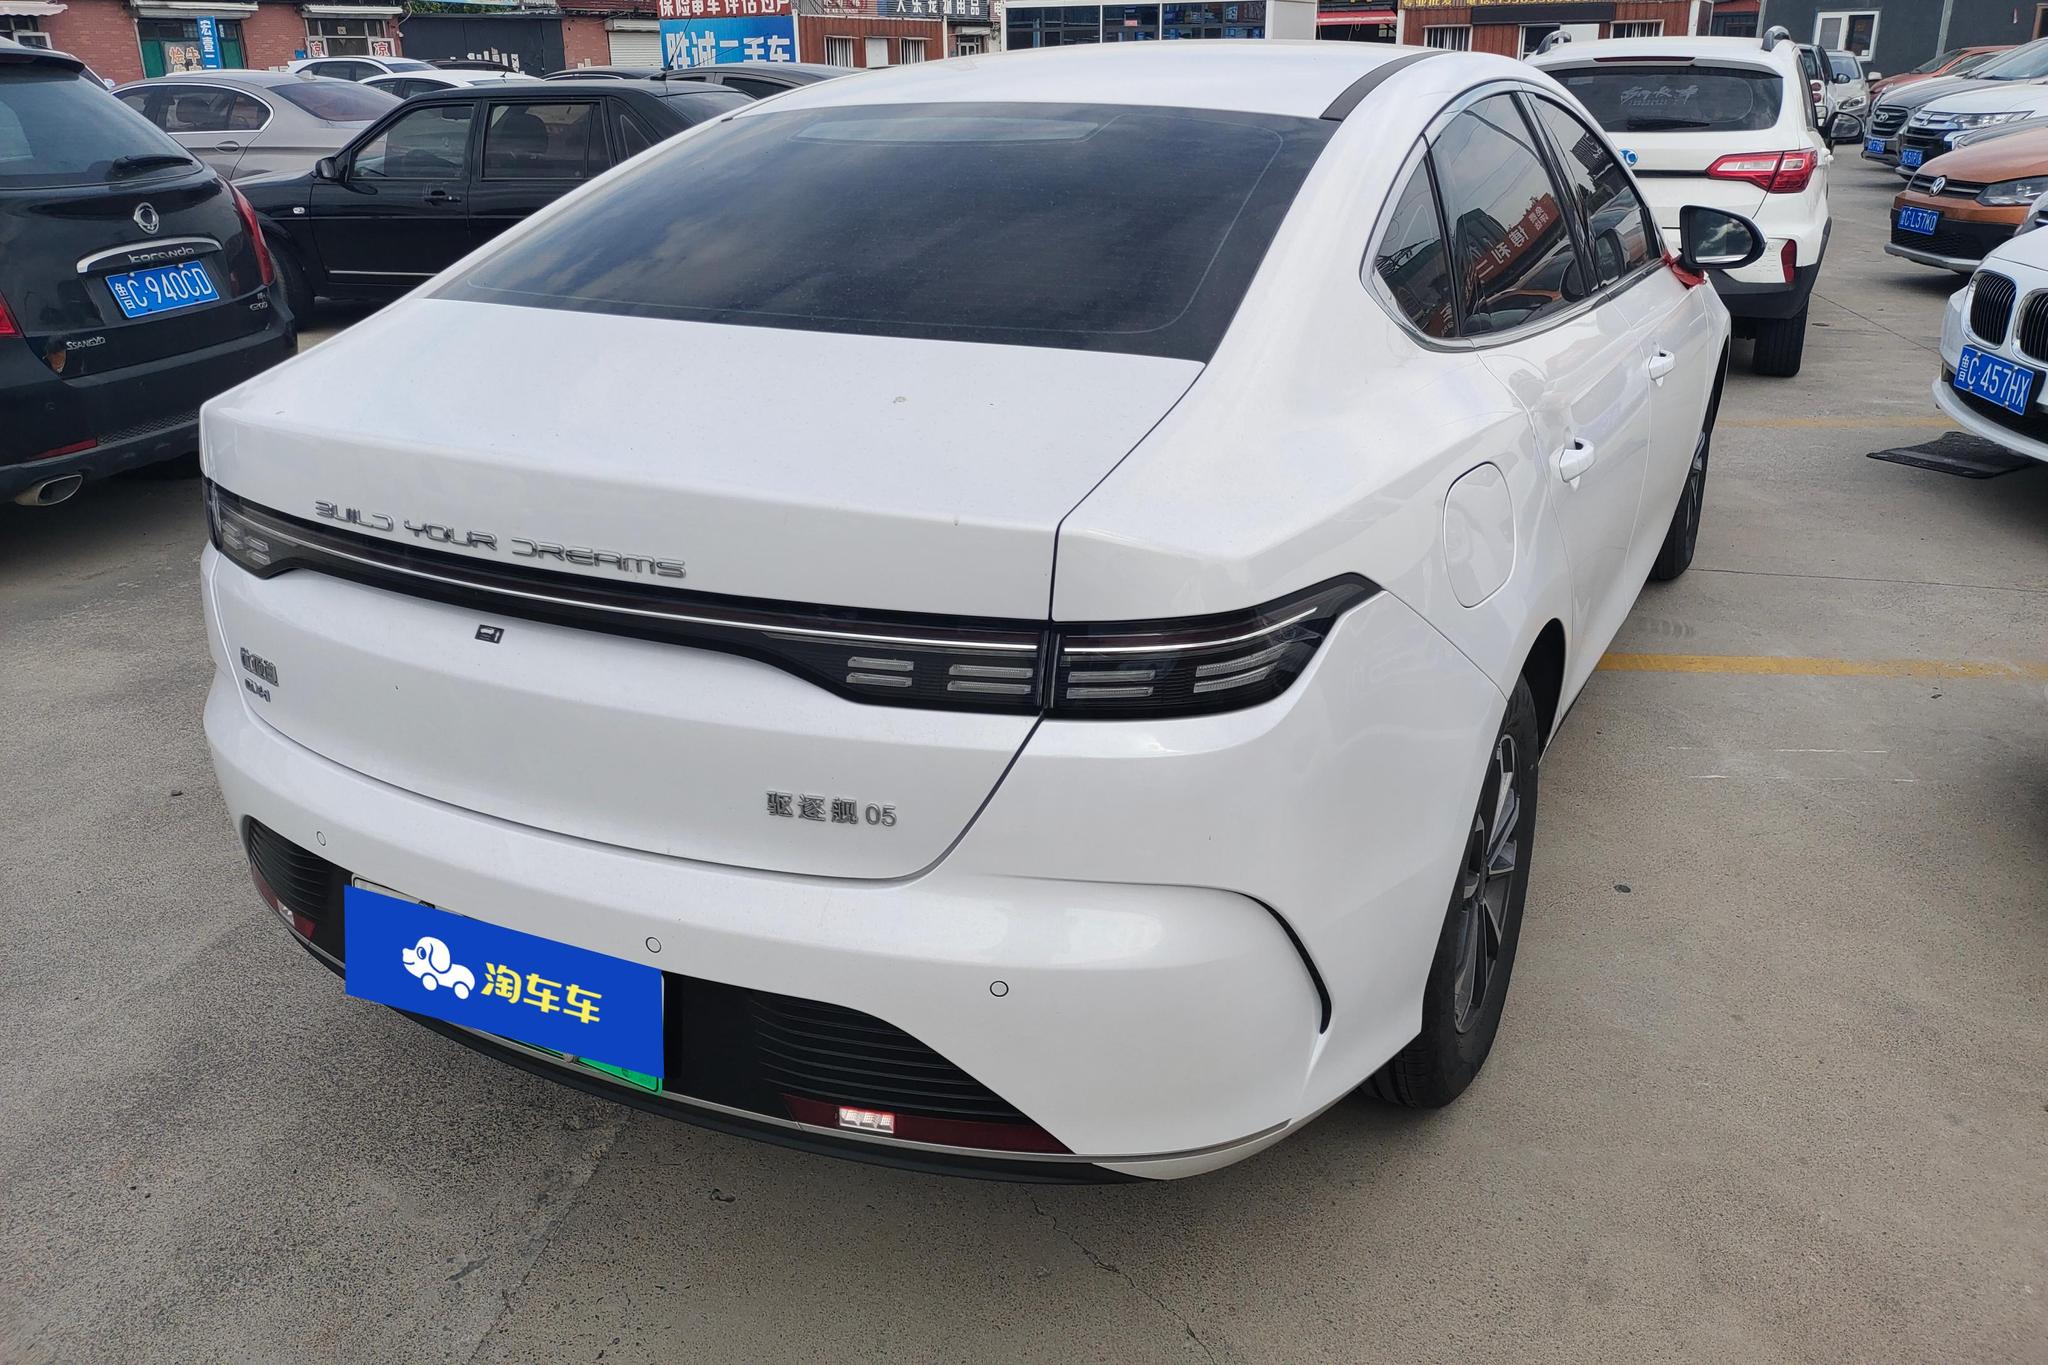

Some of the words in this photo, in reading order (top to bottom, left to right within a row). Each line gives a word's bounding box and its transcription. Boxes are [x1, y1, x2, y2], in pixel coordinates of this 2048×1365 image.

[315, 500, 394, 533] BUILD
[403, 519, 498, 551] YOUR
[511, 536, 687, 579] DREAMS
